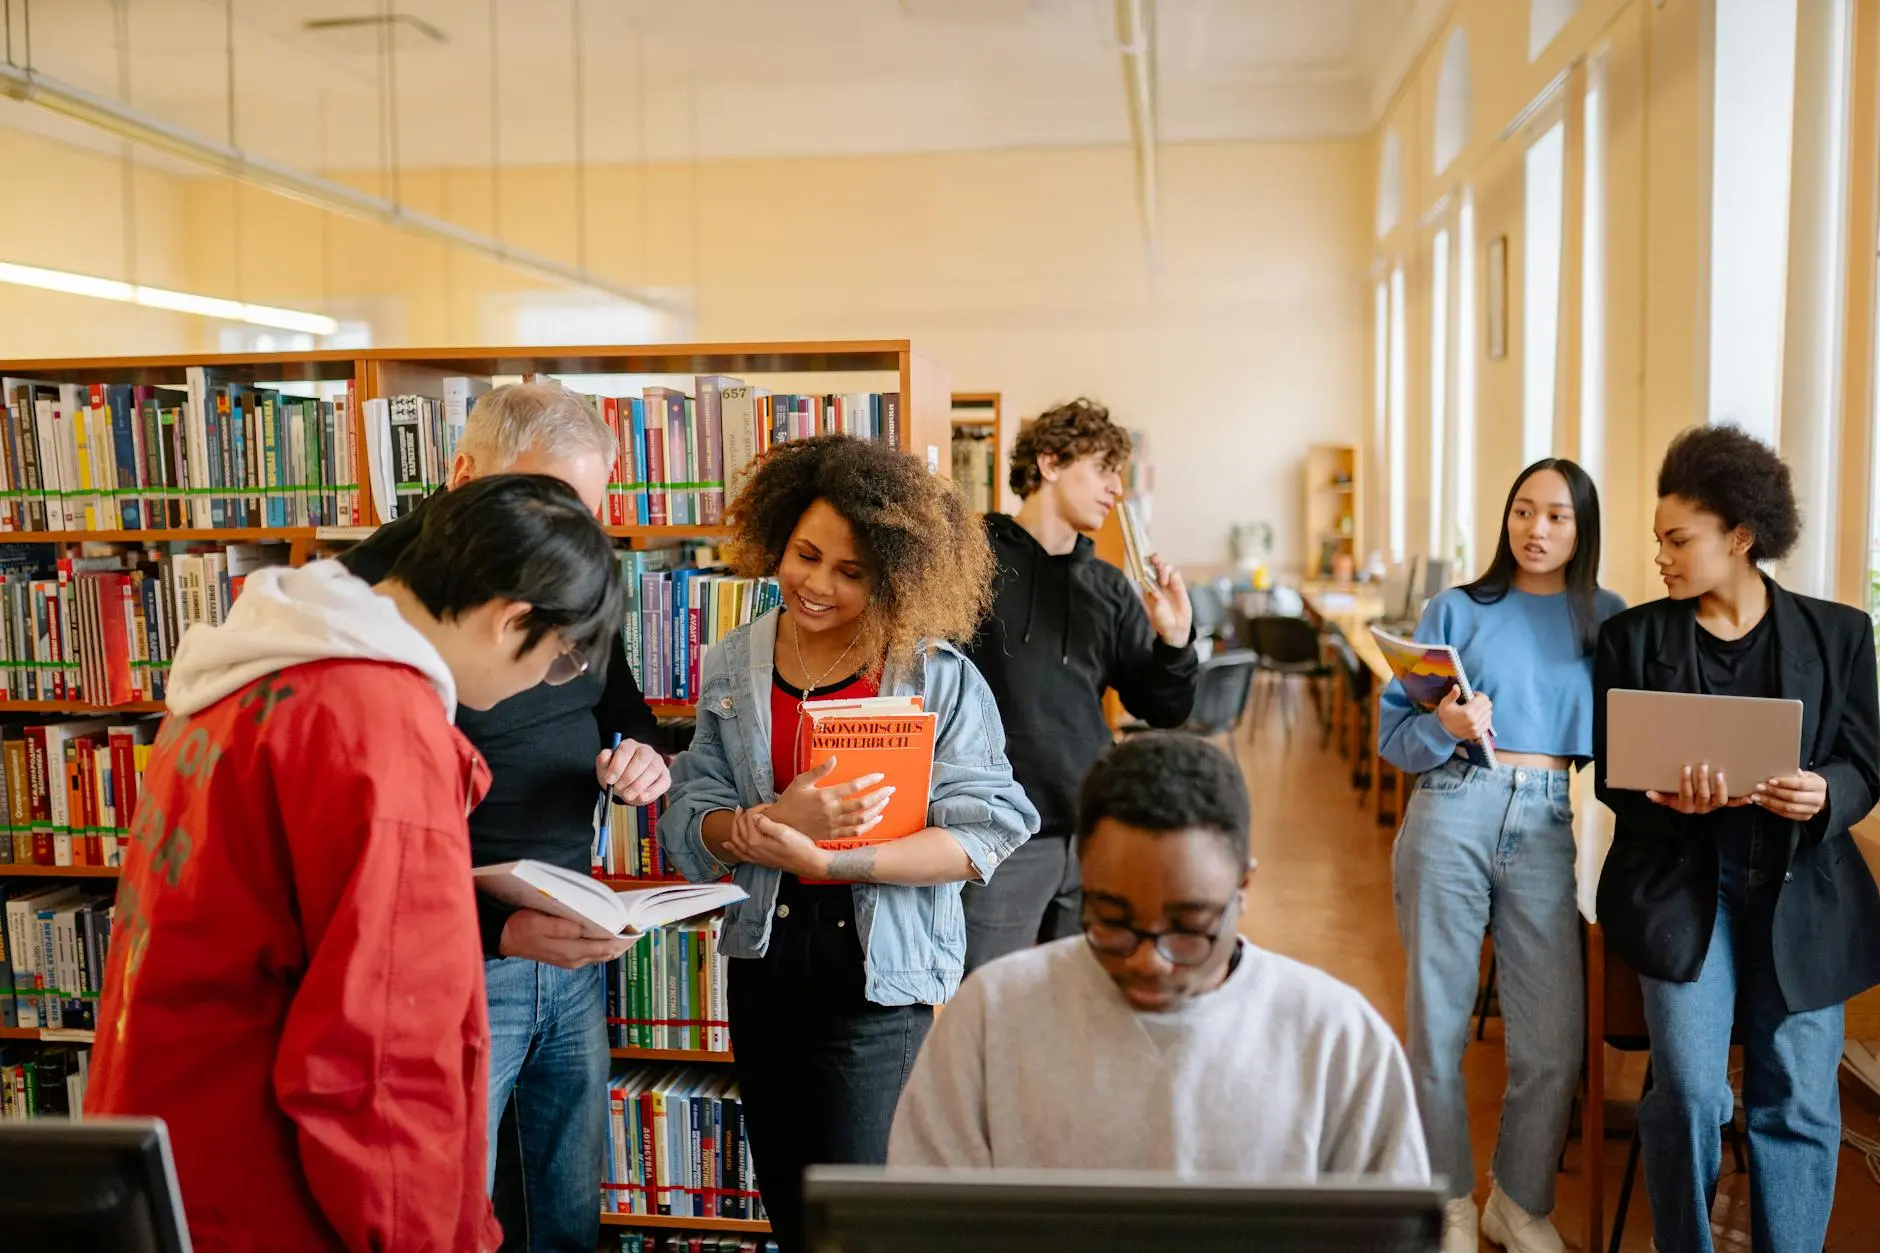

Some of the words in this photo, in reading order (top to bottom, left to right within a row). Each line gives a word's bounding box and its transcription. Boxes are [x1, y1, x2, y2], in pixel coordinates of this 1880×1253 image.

[722, 388, 747, 399] 657
[689, 613, 697, 643] АУДИТ
[149, 632, 160, 684] МАРКЕНГ
[640, 838, 651, 874] УЧЕТ
[48, 968, 59, 1022] ЭКОМИКА
[643, 1127, 652, 1179] ЛОГИСТИКА
